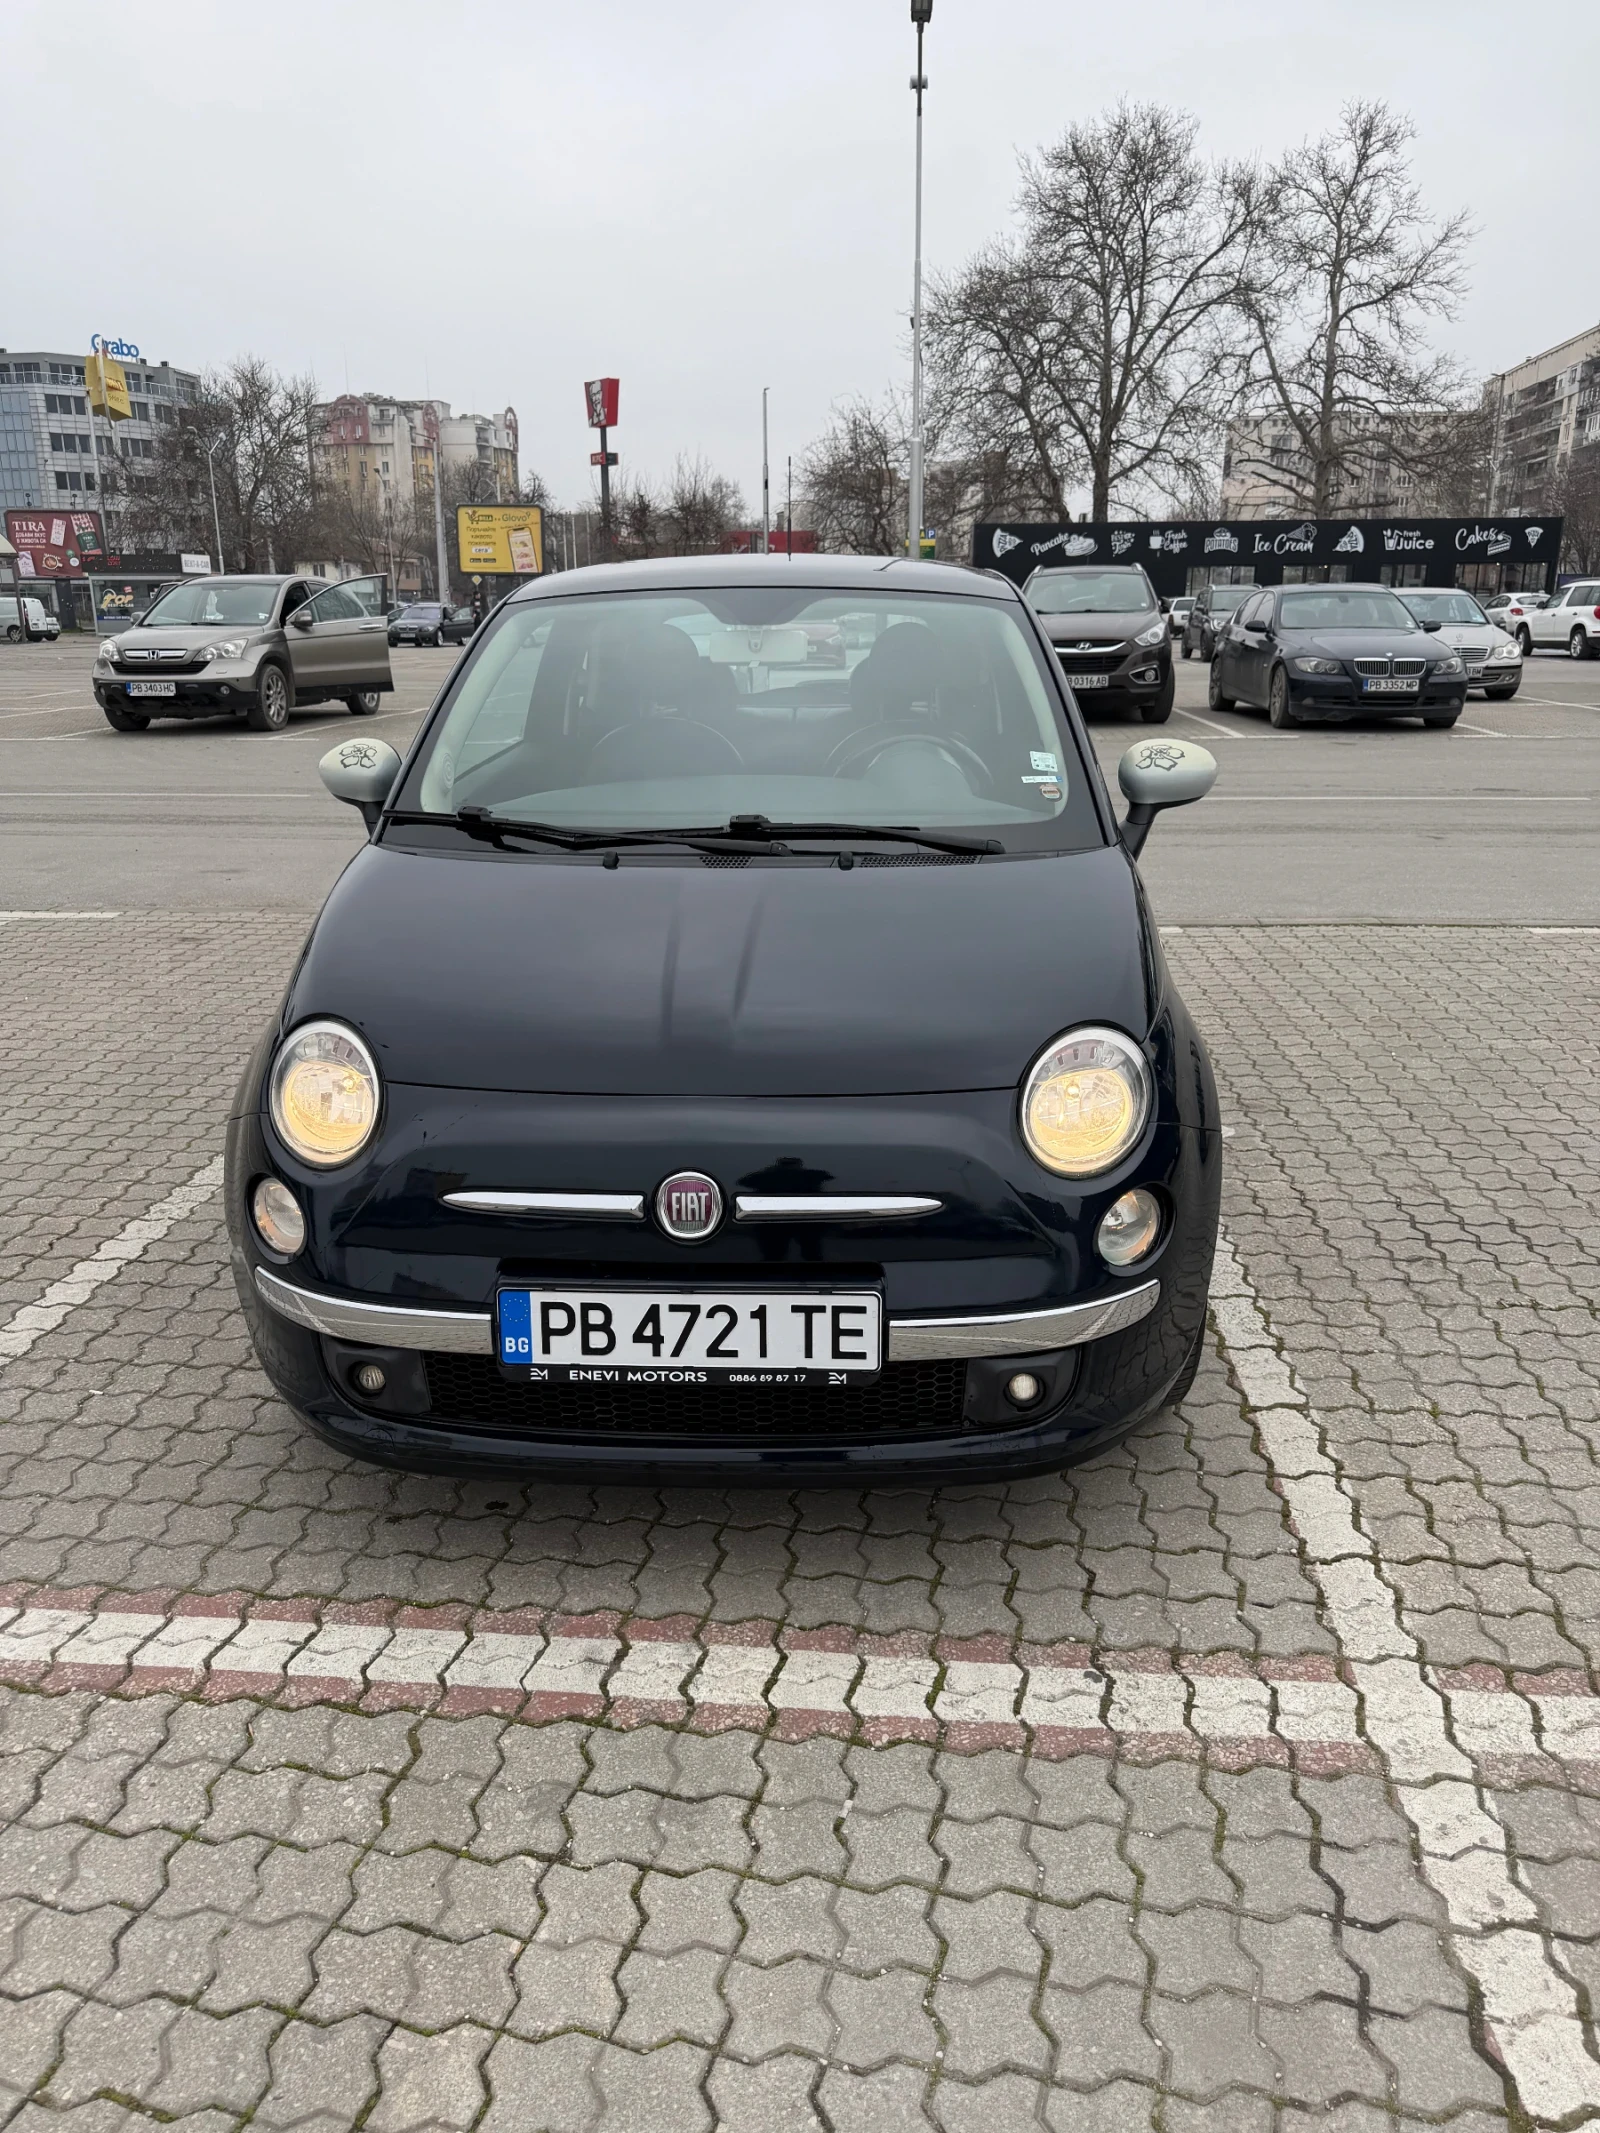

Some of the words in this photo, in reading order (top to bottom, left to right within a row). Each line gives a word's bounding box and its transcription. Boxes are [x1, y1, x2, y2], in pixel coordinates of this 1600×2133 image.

[502, 514, 527, 522] Glovo
[12, 521, 46, 531] TIRA
[928, 530, 935, 538] P
[1165, 530, 1188, 541] Fresh
[1455, 525, 1496, 550] Cakes
[1030, 532, 1069, 556] Pancake
[1163, 540, 1188, 553] Coffee
[1204, 537, 1239, 553] POTATOES
[1253, 533, 1271, 553] Ice
[1274, 533, 1314, 554] Cream
[1397, 537, 1435, 550] Juice
[184, 560, 209, 568] RENT-A-CAR
[101, 593, 134, 608] TOP
[1074, 677, 1094, 685] 0316
[1096, 676, 1107, 685] AB
[1369, 680, 1380, 690] PB
[1383, 680, 1405, 690] 3352
[1406, 680, 1417, 690] MP
[132, 684, 142, 692] PB
[144, 684, 162, 692] 3403
[163, 684, 174, 692] HC
[671, 1192, 709, 1221] FIAT
[540, 1301, 617, 1356] PB
[632, 1303, 767, 1358] 4721
[791, 1305, 867, 1360] TE
[505, 1337, 528, 1353] BG
[569, 1370, 619, 1381] ENEVI
[627, 1371, 707, 1382] MOTORS
[729, 1374, 757, 1382] 0886
[760, 1374, 773, 1382] 89
[776, 1374, 789, 1382] 87
